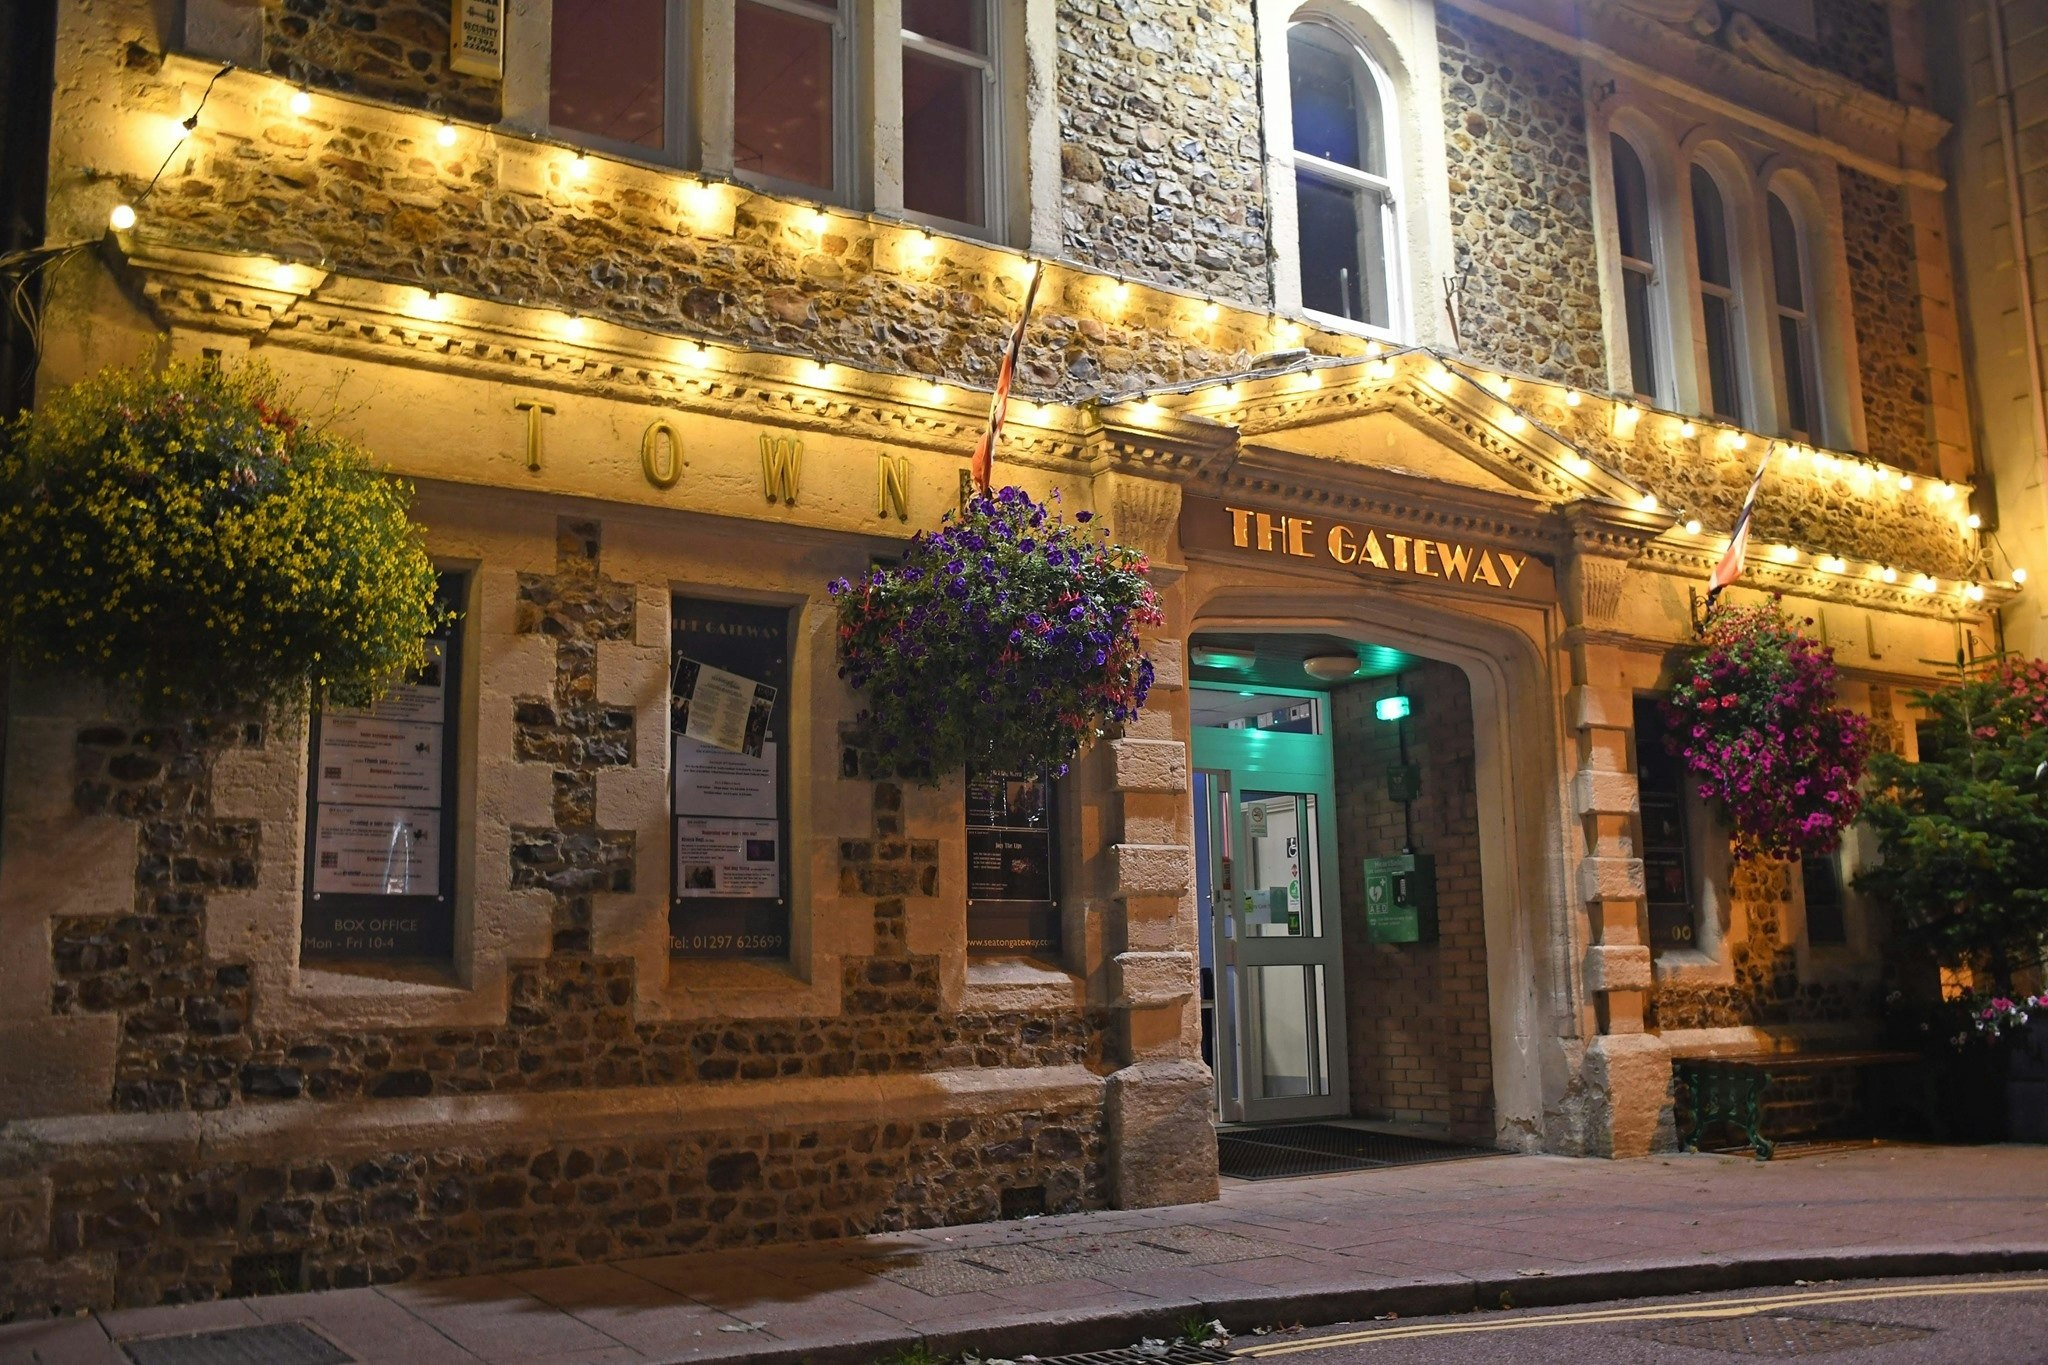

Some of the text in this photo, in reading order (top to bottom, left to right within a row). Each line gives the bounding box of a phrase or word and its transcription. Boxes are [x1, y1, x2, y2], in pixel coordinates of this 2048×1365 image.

[464, 21, 498, 38] SECURITY
[514, 397, 910, 522] TOWN
[1225, 507, 1526, 589] THE GATEWAY
[334, 919, 418, 932] BOX OFFICE
[304, 937, 333, 950] Mon
[346, 937, 363, 949] Fri
[369, 937, 395, 949] 10-4
[693, 936, 733, 949] 01297
[736, 936, 783, 949] 625699
